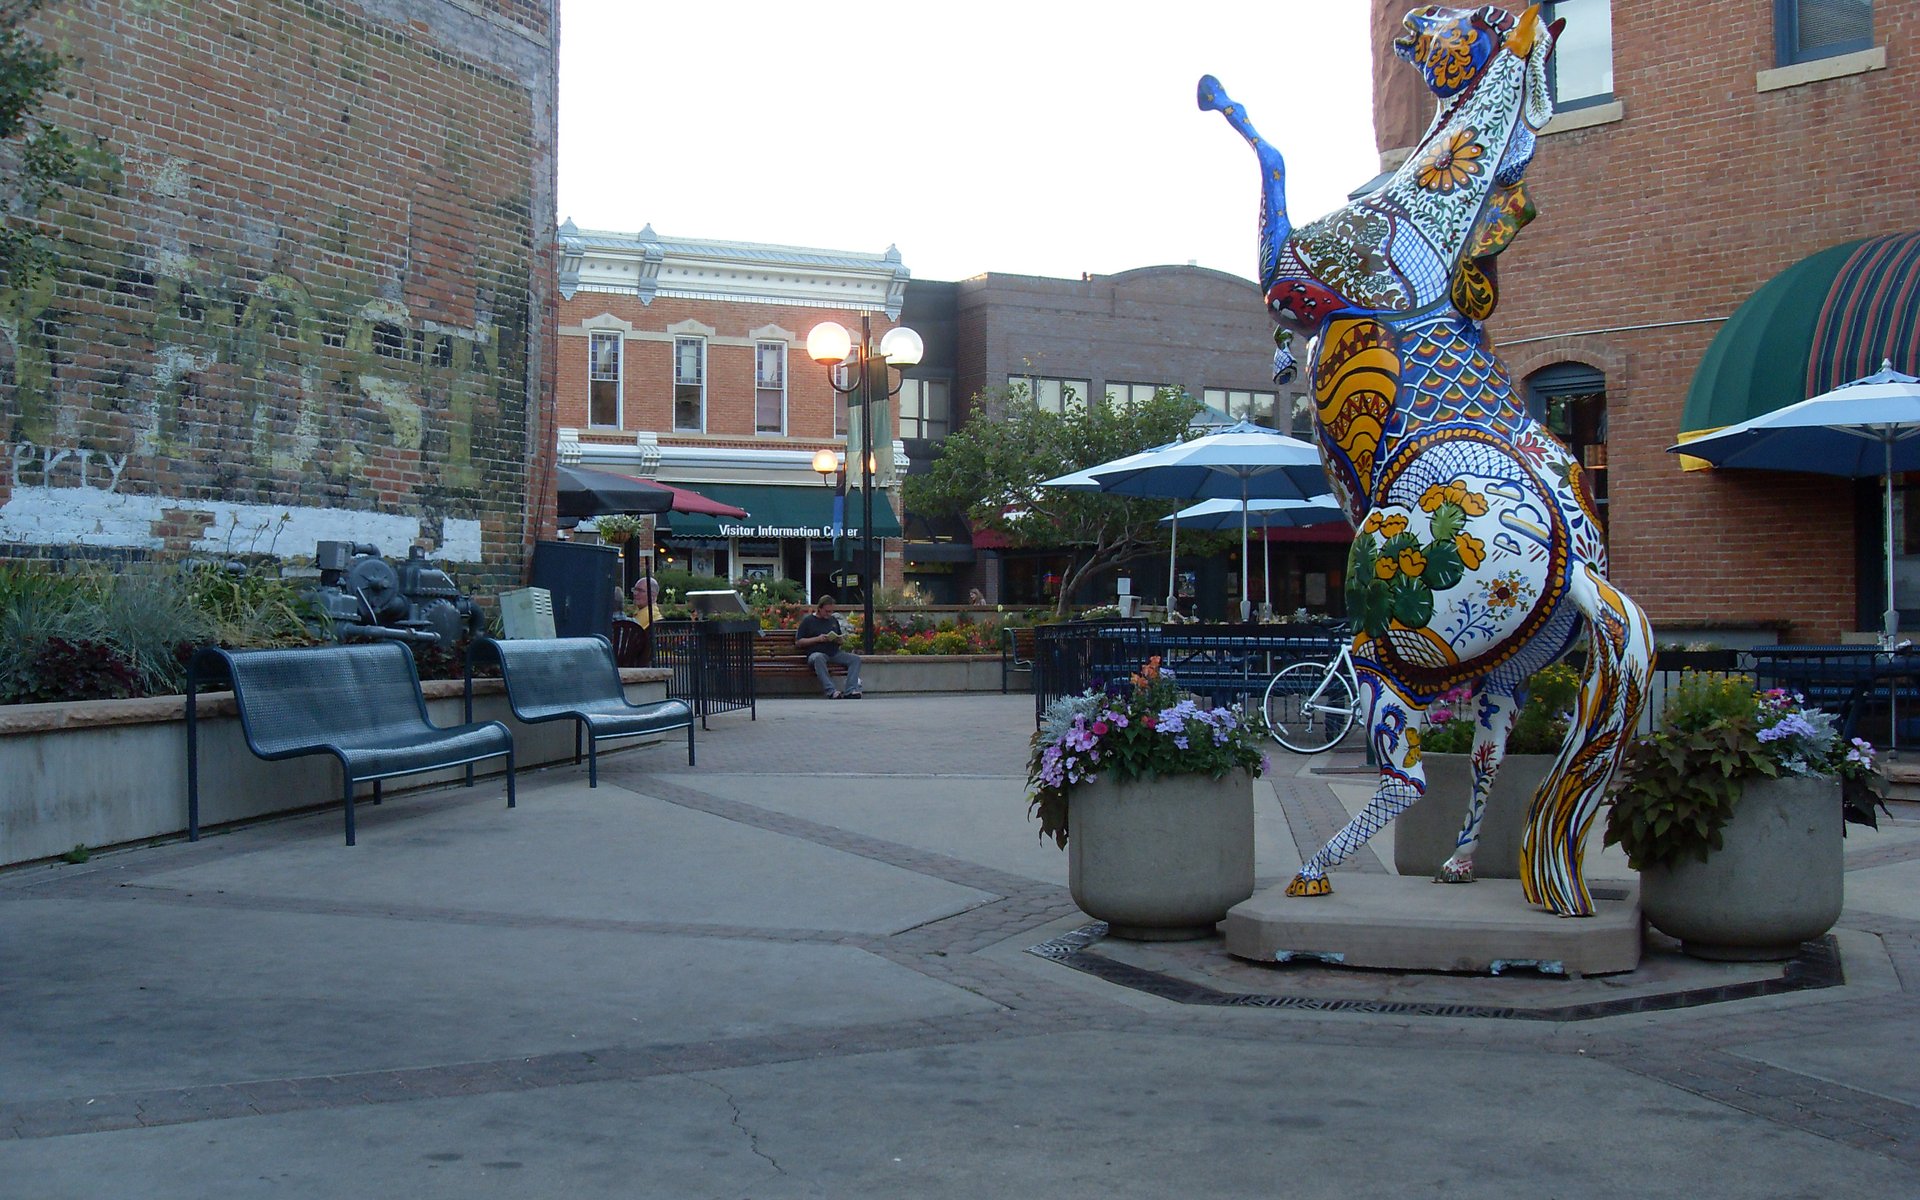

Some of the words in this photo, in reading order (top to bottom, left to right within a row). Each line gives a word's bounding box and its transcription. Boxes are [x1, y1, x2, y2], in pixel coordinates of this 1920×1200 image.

[719, 524, 755, 537] Visitor
[758, 525, 820, 537] Information
[823, 526, 858, 537] Cner
